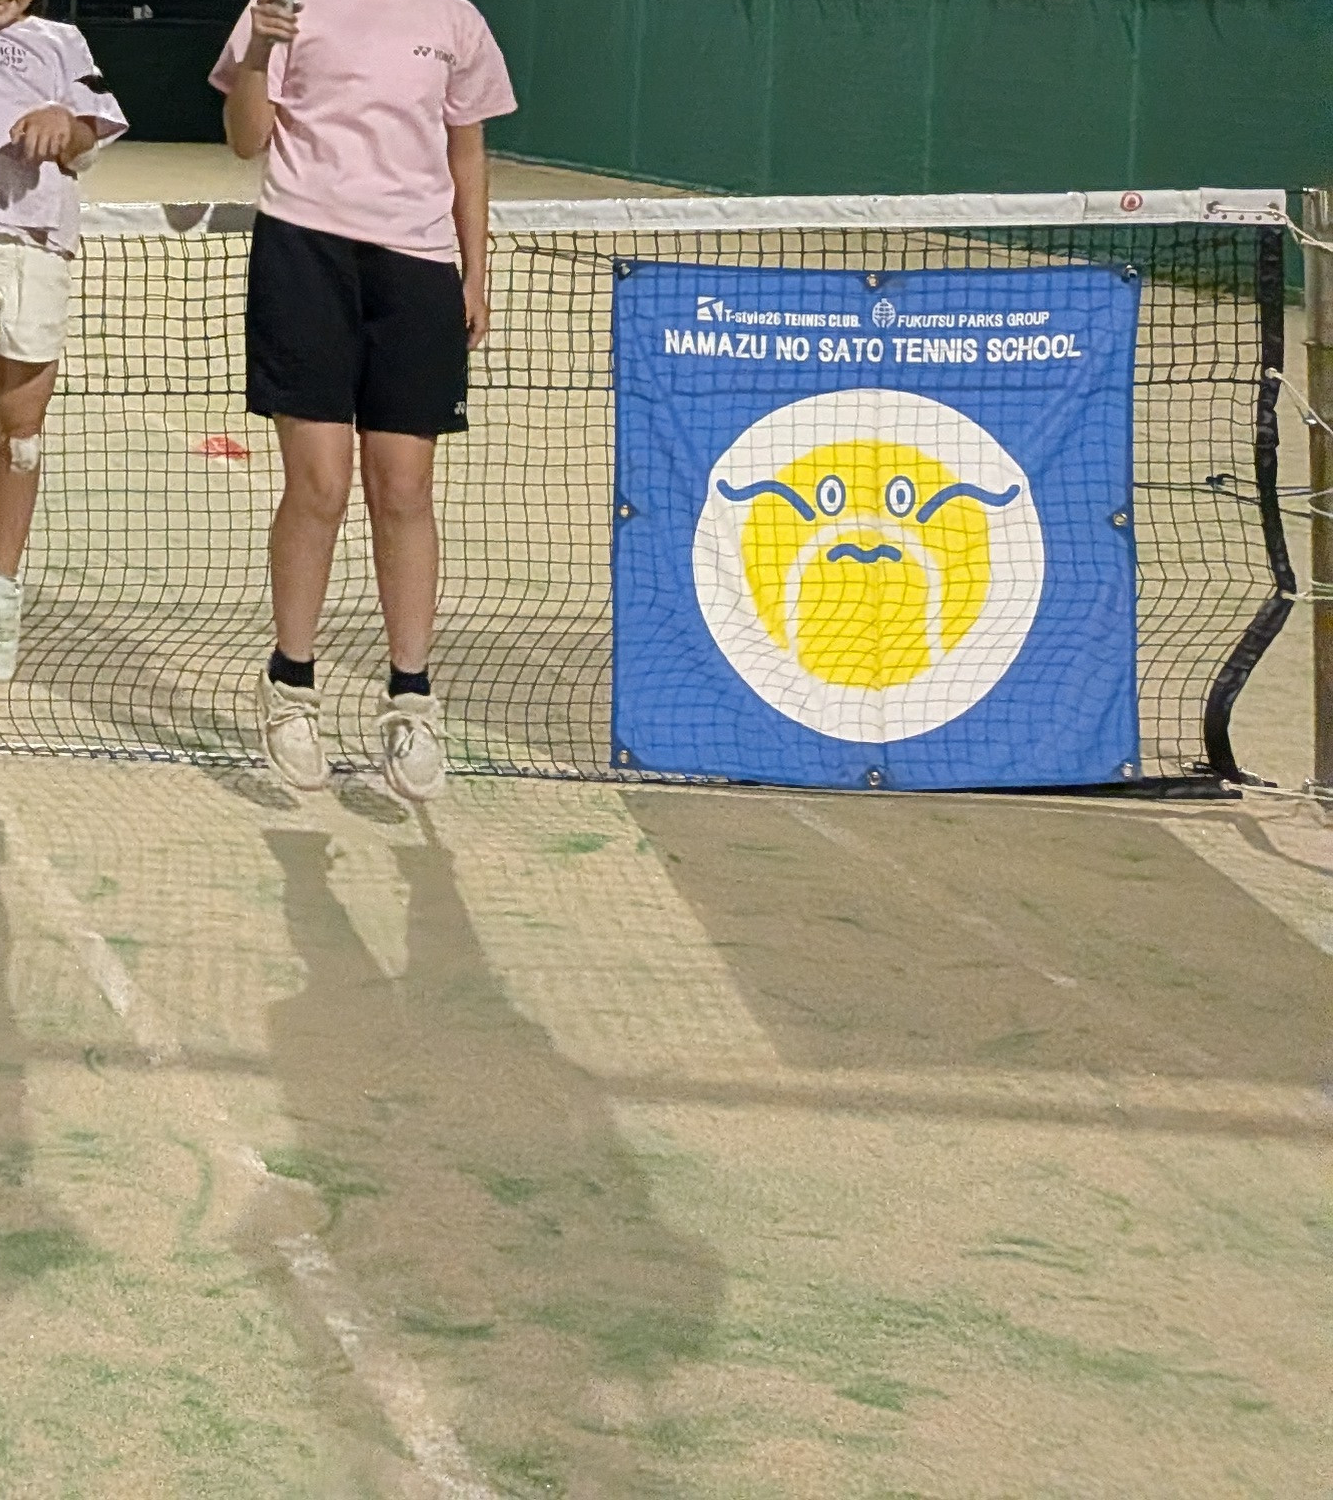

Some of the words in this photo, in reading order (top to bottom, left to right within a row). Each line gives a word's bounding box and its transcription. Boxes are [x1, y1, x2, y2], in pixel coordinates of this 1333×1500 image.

[784, 313, 826, 328] TENNIS
[897, 313, 955, 328] FUKUTSU
[958, 313, 1003, 328] PARKS
[1007, 311, 1050, 327] GROUP
[664, 328, 767, 360] NAMAZU
[775, 335, 810, 361] NO
[818, 337, 884, 363] SATO
[892, 337, 978, 363] TENNIS
[986, 333, 1081, 363] SCHOOL
